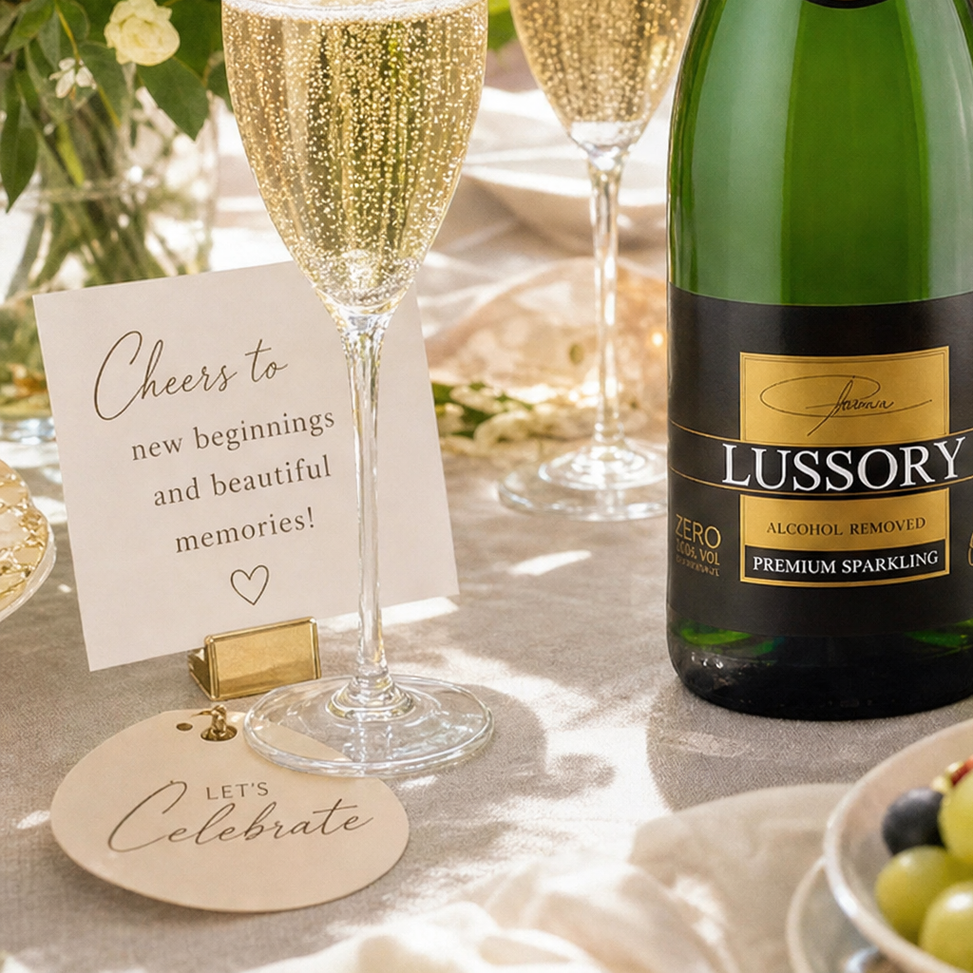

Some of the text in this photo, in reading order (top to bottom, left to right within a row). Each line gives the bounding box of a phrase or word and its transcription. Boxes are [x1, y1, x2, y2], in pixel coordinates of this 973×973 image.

[93, 330, 288, 421] Cheers to
[131, 408, 335, 461] new beginnings
[154, 455, 332, 507] and beautiful
[722, 437, 966, 491] LUSSORY
[175, 506, 315, 553] memories!
[675, 513, 721, 549] ZERO
[766, 517, 926, 536] ALCOHOL REMOVED
[699, 548, 720, 565] VOL
[752, 550, 939, 574] PREMIUM SPARKLING
[206, 781, 270, 801] LET'S
[107, 780, 374, 853] Celebrate
